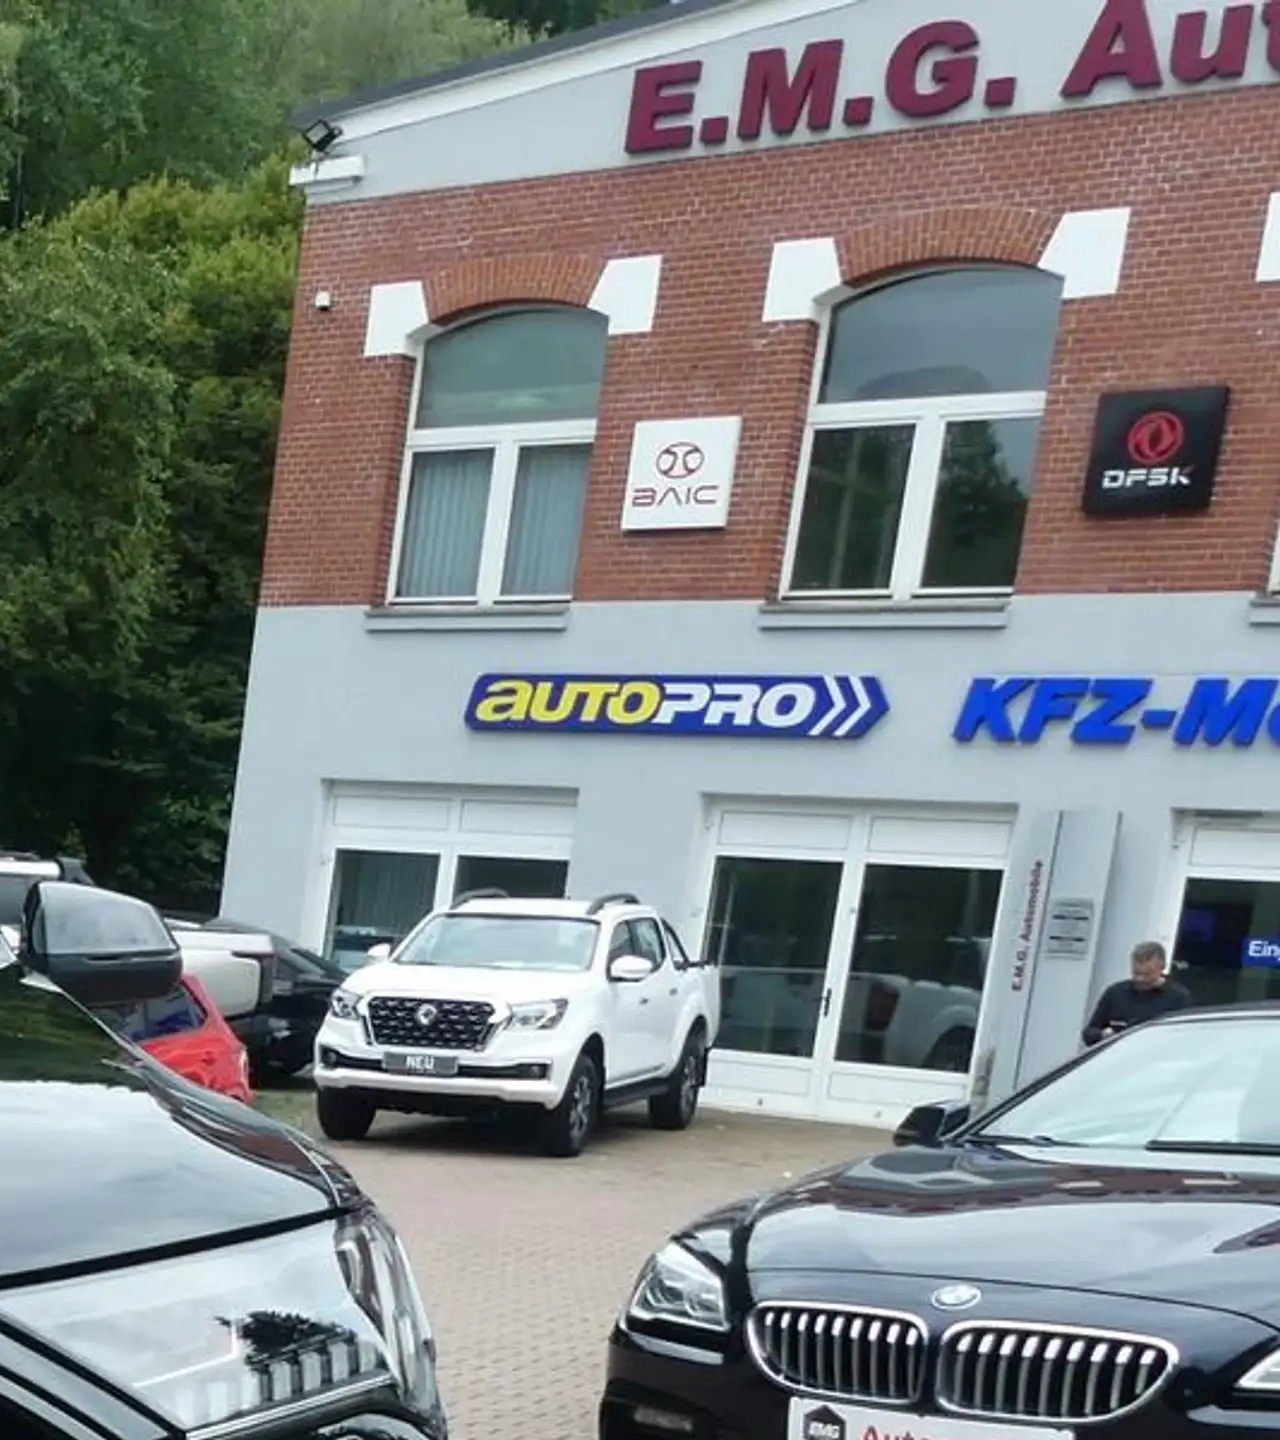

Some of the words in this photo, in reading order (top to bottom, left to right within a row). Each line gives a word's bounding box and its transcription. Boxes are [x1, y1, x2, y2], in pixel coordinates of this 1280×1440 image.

[625, 19, 1017, 154] E.M.G.
[1102, 465, 1195, 489] DFSK
[632, 485, 719, 507] BAIC
[951, 676, 1280, 748] KFZ-M
[1249, 940, 1280, 961] Ein
